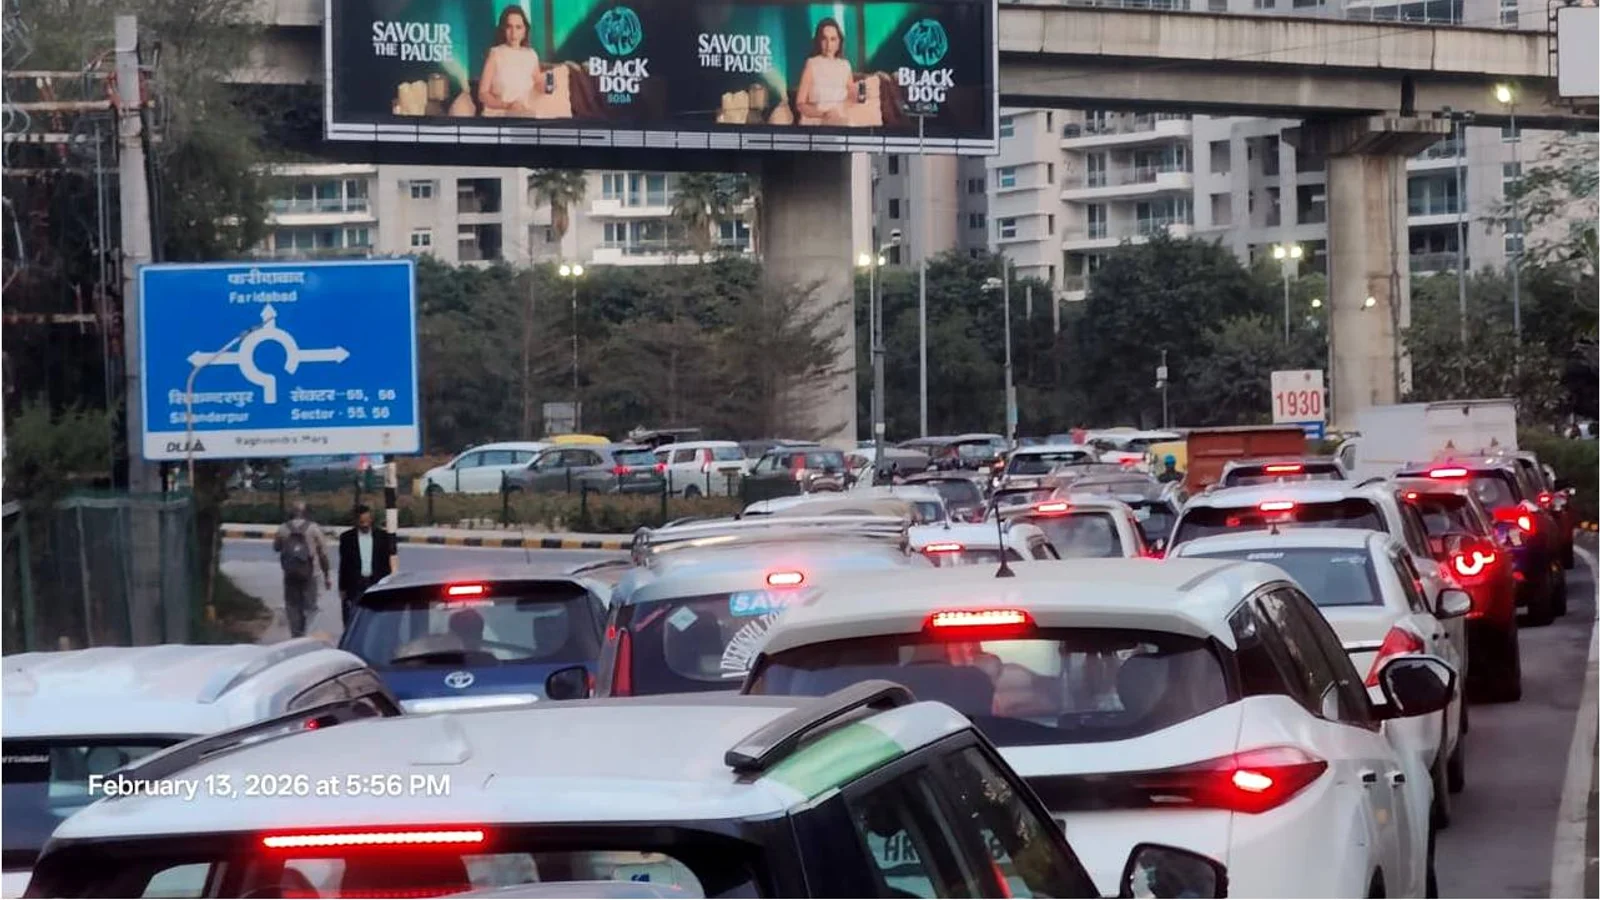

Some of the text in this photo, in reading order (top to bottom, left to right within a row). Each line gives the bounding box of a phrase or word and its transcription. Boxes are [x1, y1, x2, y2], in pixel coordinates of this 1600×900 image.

[372, 21, 452, 43] SAVOUR
[373, 43, 452, 61] THE PAUSE
[699, 33, 771, 55] SAVOUR
[589, 57, 649, 77] BLACK
[699, 54, 772, 73] THE PAUSE
[600, 75, 640, 93] DOG
[899, 67, 955, 87] BLACK
[607, 93, 632, 103] SODA
[908, 86, 946, 103] DOG
[229, 290, 298, 304] Faridabad
[378, 389, 397, 401] 56
[1276, 390, 1321, 416] 1930
[291, 408, 336, 421] Sector
[372, 406, 391, 419] 56
[302, 434, 328, 445] Marg
